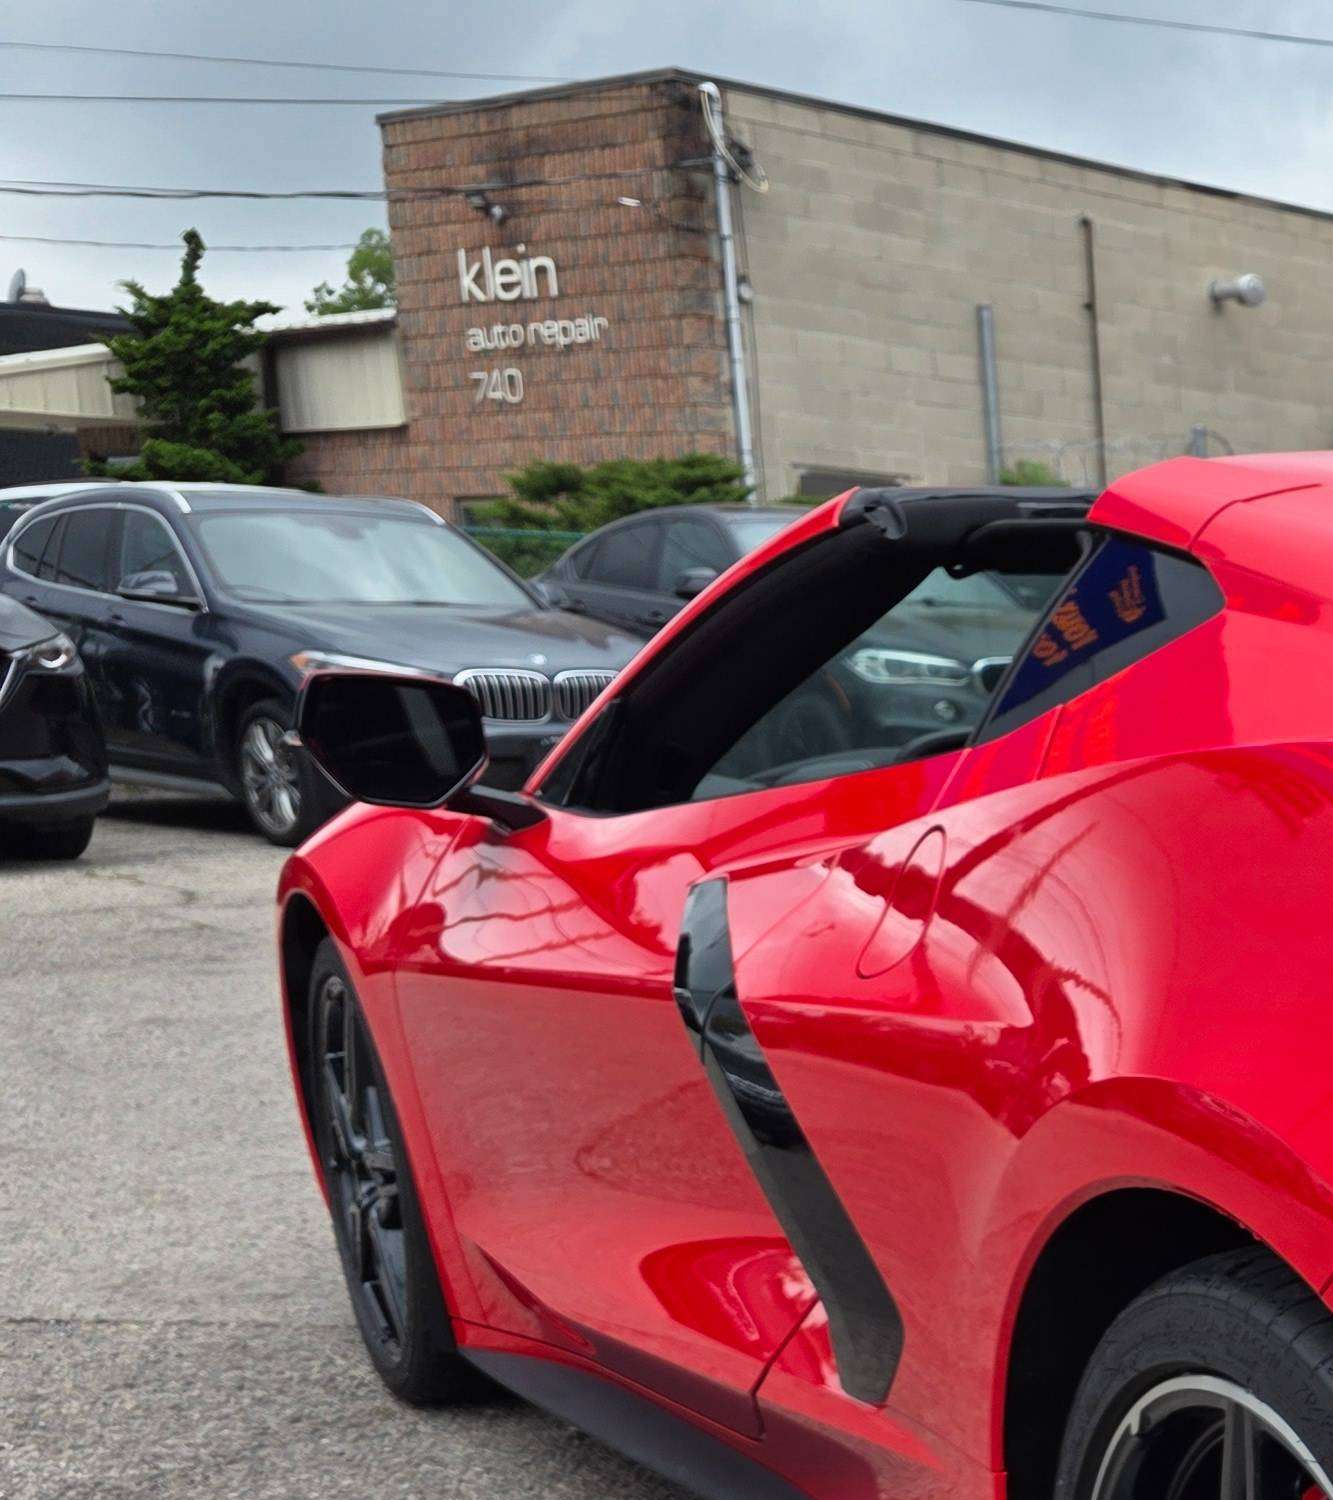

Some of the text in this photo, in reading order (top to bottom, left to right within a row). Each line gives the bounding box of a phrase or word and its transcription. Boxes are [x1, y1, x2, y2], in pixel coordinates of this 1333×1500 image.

[457, 243, 559, 302] klein
[465, 313, 609, 352] auto repair
[468, 367, 525, 404] 740
